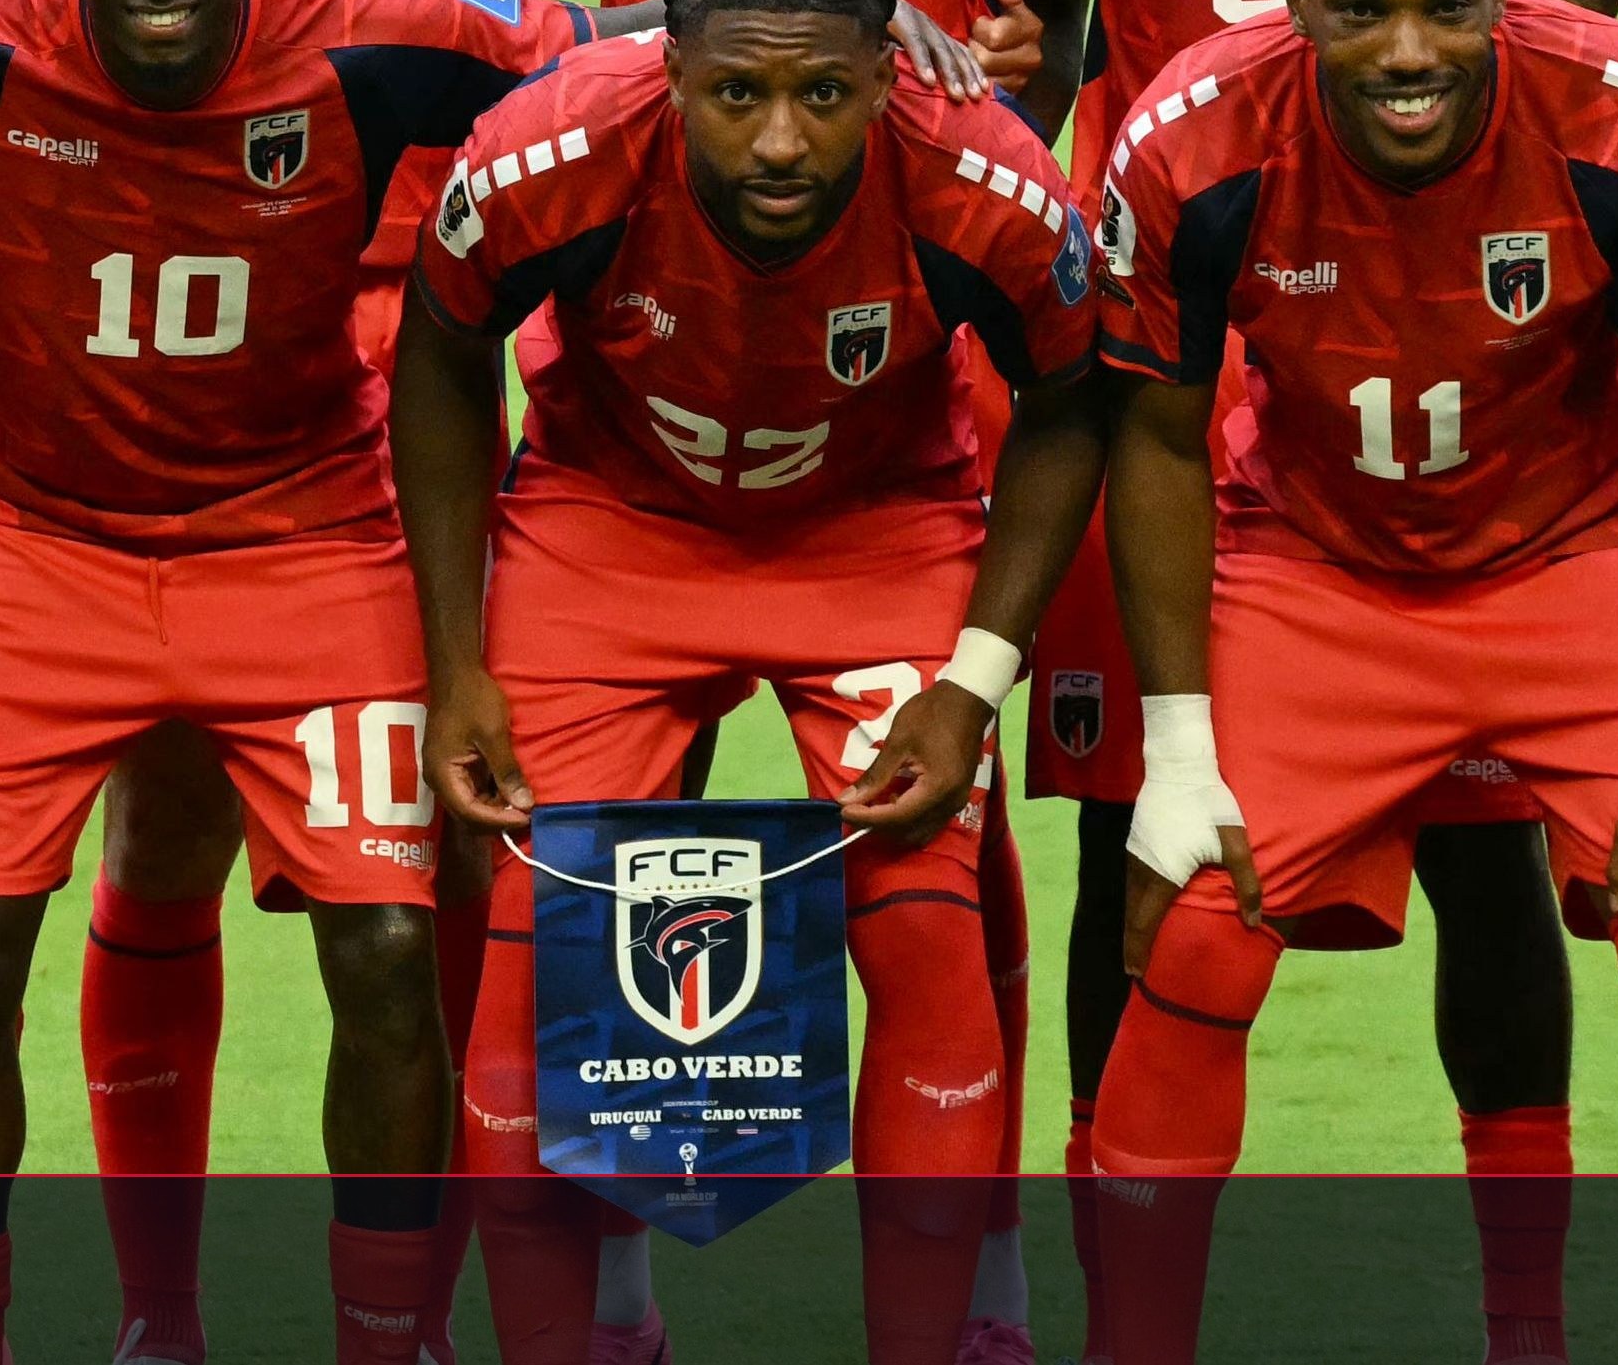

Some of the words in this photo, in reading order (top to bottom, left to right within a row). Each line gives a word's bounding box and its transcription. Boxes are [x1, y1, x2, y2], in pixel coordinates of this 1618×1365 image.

[249, 114, 305, 133] FCF
[7, 129, 100, 157] capelli
[48, 154, 99, 168] SPORT
[1487, 237, 1543, 254] FCF
[1254, 260, 1338, 292] capelli
[1287, 284, 1338, 296] SPORT
[86, 252, 251, 358] 10
[832, 306, 887, 326] FCF
[645, 395, 830, 488] 22
[1349, 376, 1471, 481] 11
[1054, 673, 1100, 688] FCF
[295, 700, 435, 827] 10
[629, 848, 749, 882] FCF
[579, 1057, 677, 1084] CABO
[682, 1054, 803, 1080] VERDE
[904, 1068, 999, 1109] capelli
[589, 1109, 662, 1125] URUGUAI
[701, 1108, 746, 1122] CABO
[749, 1107, 803, 1121] VERDE
